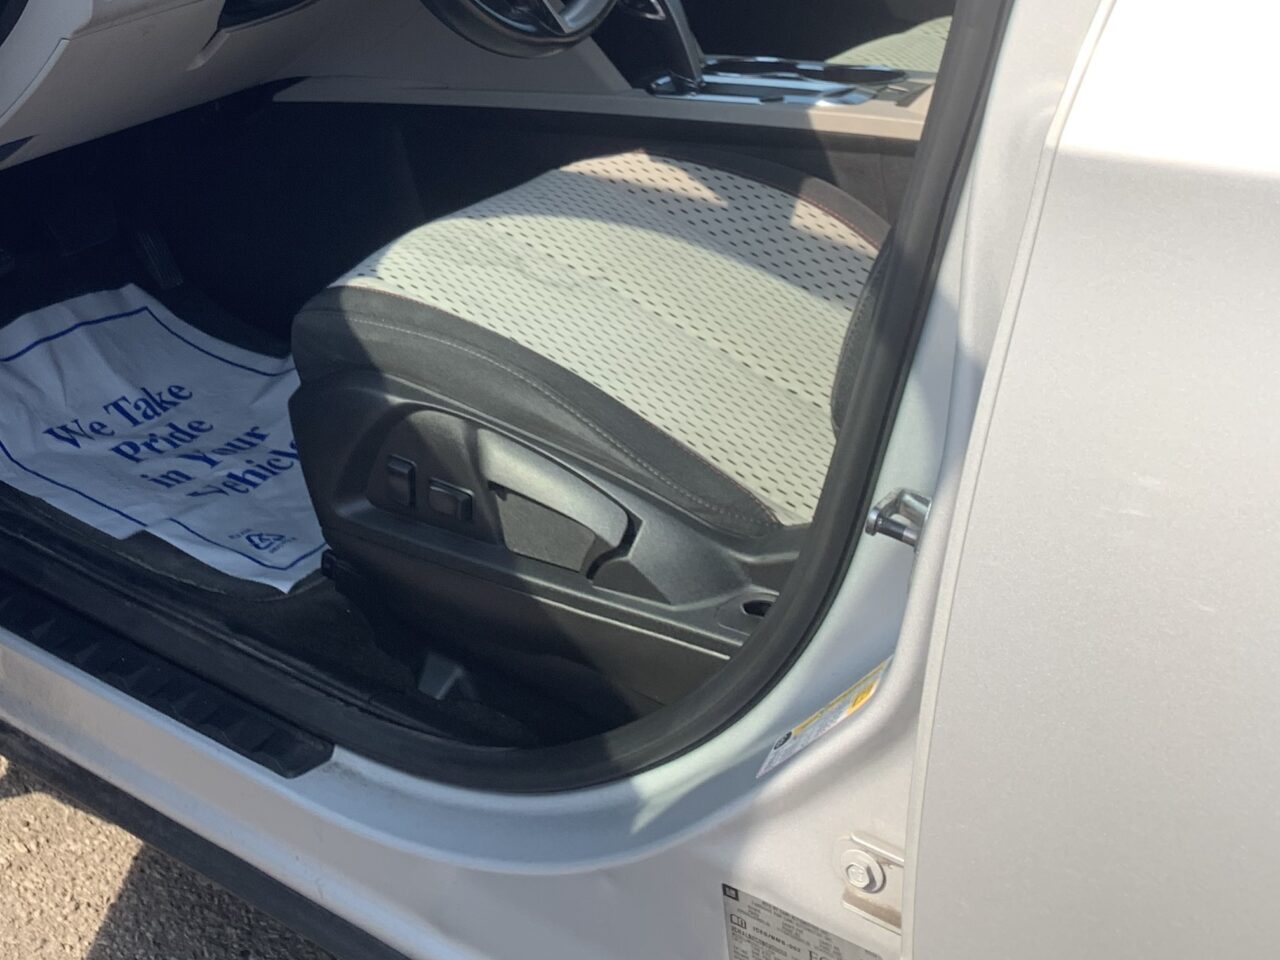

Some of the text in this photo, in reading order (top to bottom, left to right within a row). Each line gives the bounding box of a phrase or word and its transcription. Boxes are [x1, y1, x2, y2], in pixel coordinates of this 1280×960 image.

[42, 385, 193, 449] We Take
[109, 420, 214, 464] Pride
[140, 426, 270, 489] in Your
[186, 441, 299, 497] Vehicl
